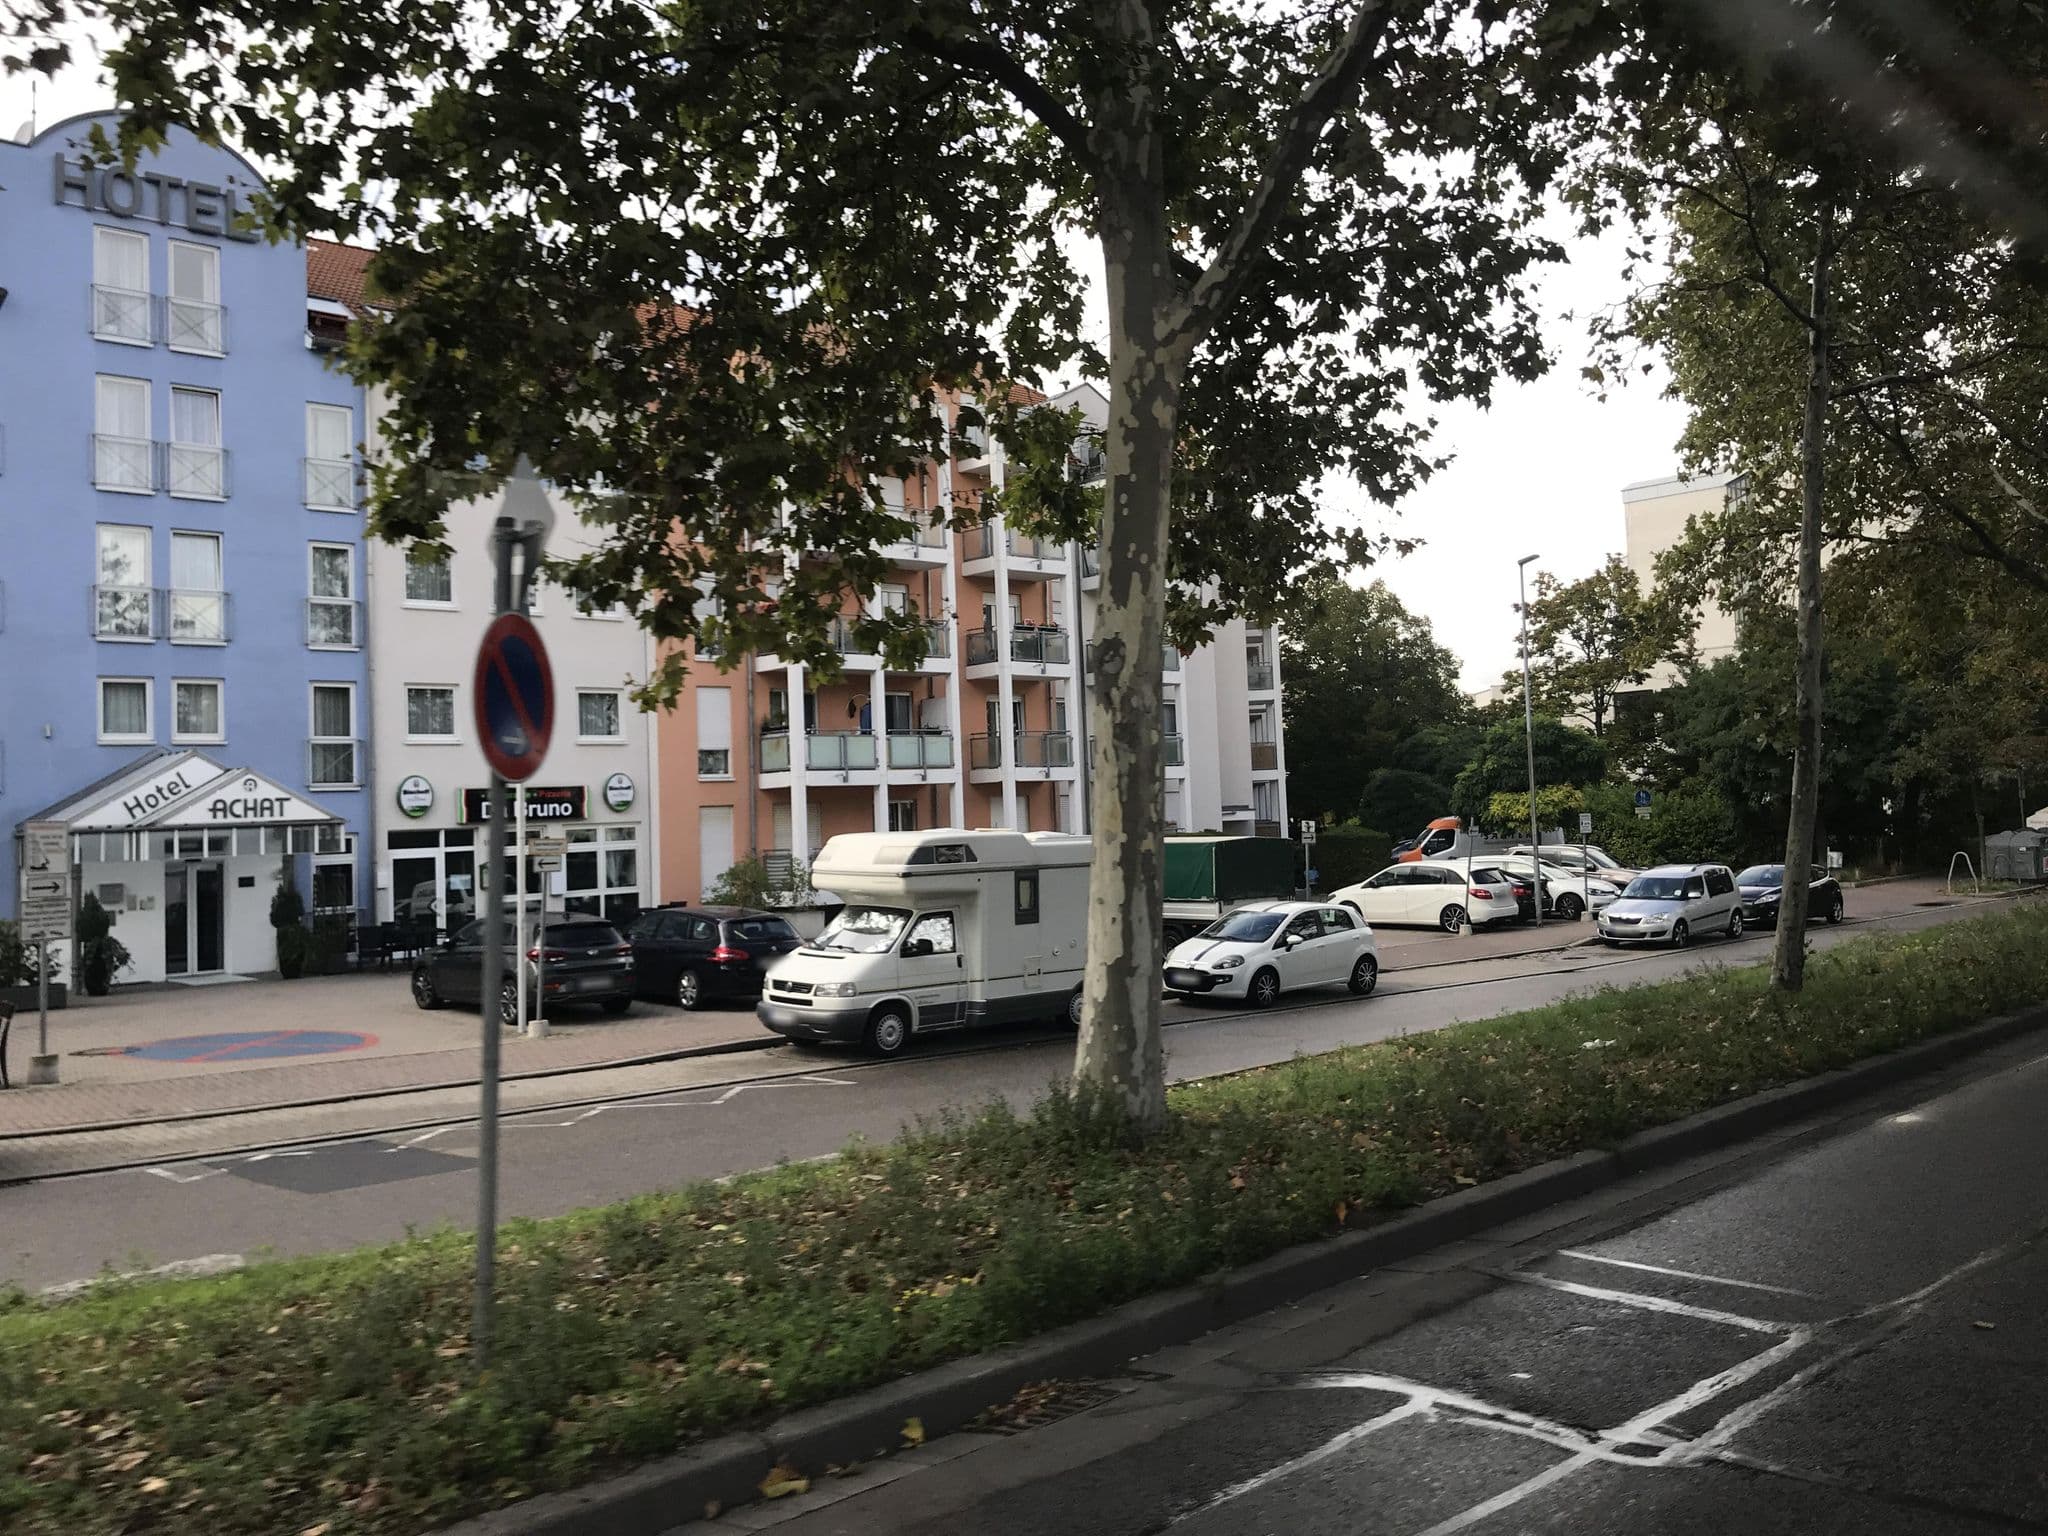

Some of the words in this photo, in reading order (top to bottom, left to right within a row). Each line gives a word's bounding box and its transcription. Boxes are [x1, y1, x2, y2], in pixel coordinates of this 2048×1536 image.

[54, 152, 261, 243] HOTEL
[123, 772, 191, 820] Hotel
[208, 797, 291, 819] ACHAT
[481, 801, 508, 819] D
